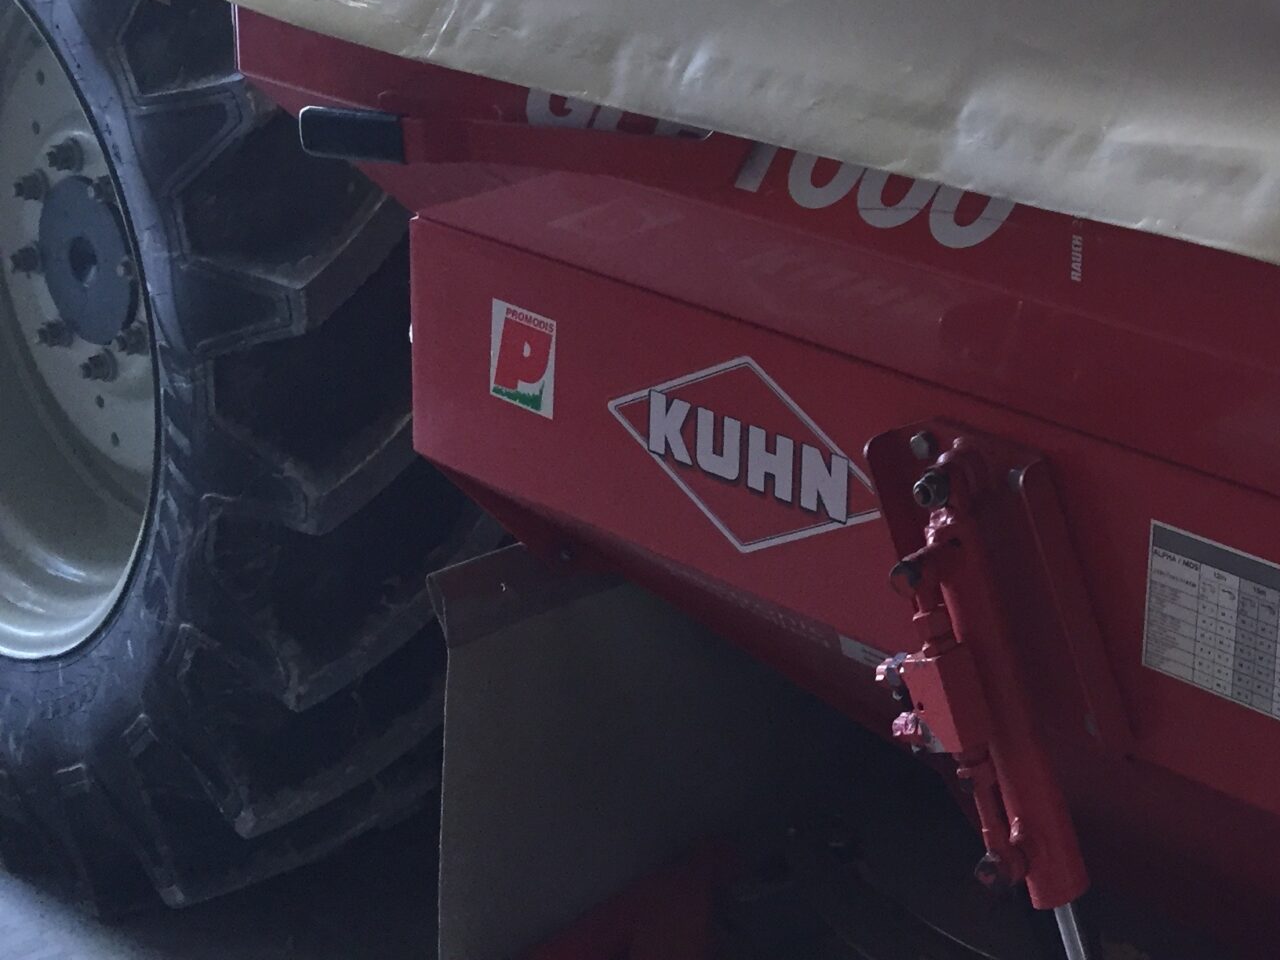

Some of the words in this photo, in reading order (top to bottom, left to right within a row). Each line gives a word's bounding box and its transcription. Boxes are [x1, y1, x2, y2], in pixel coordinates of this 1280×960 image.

[1069, 234, 1083, 282] RAUCH
[505, 306, 555, 334] PROMODIS
[494, 317, 553, 391] P
[646, 388, 851, 524] KUHN
